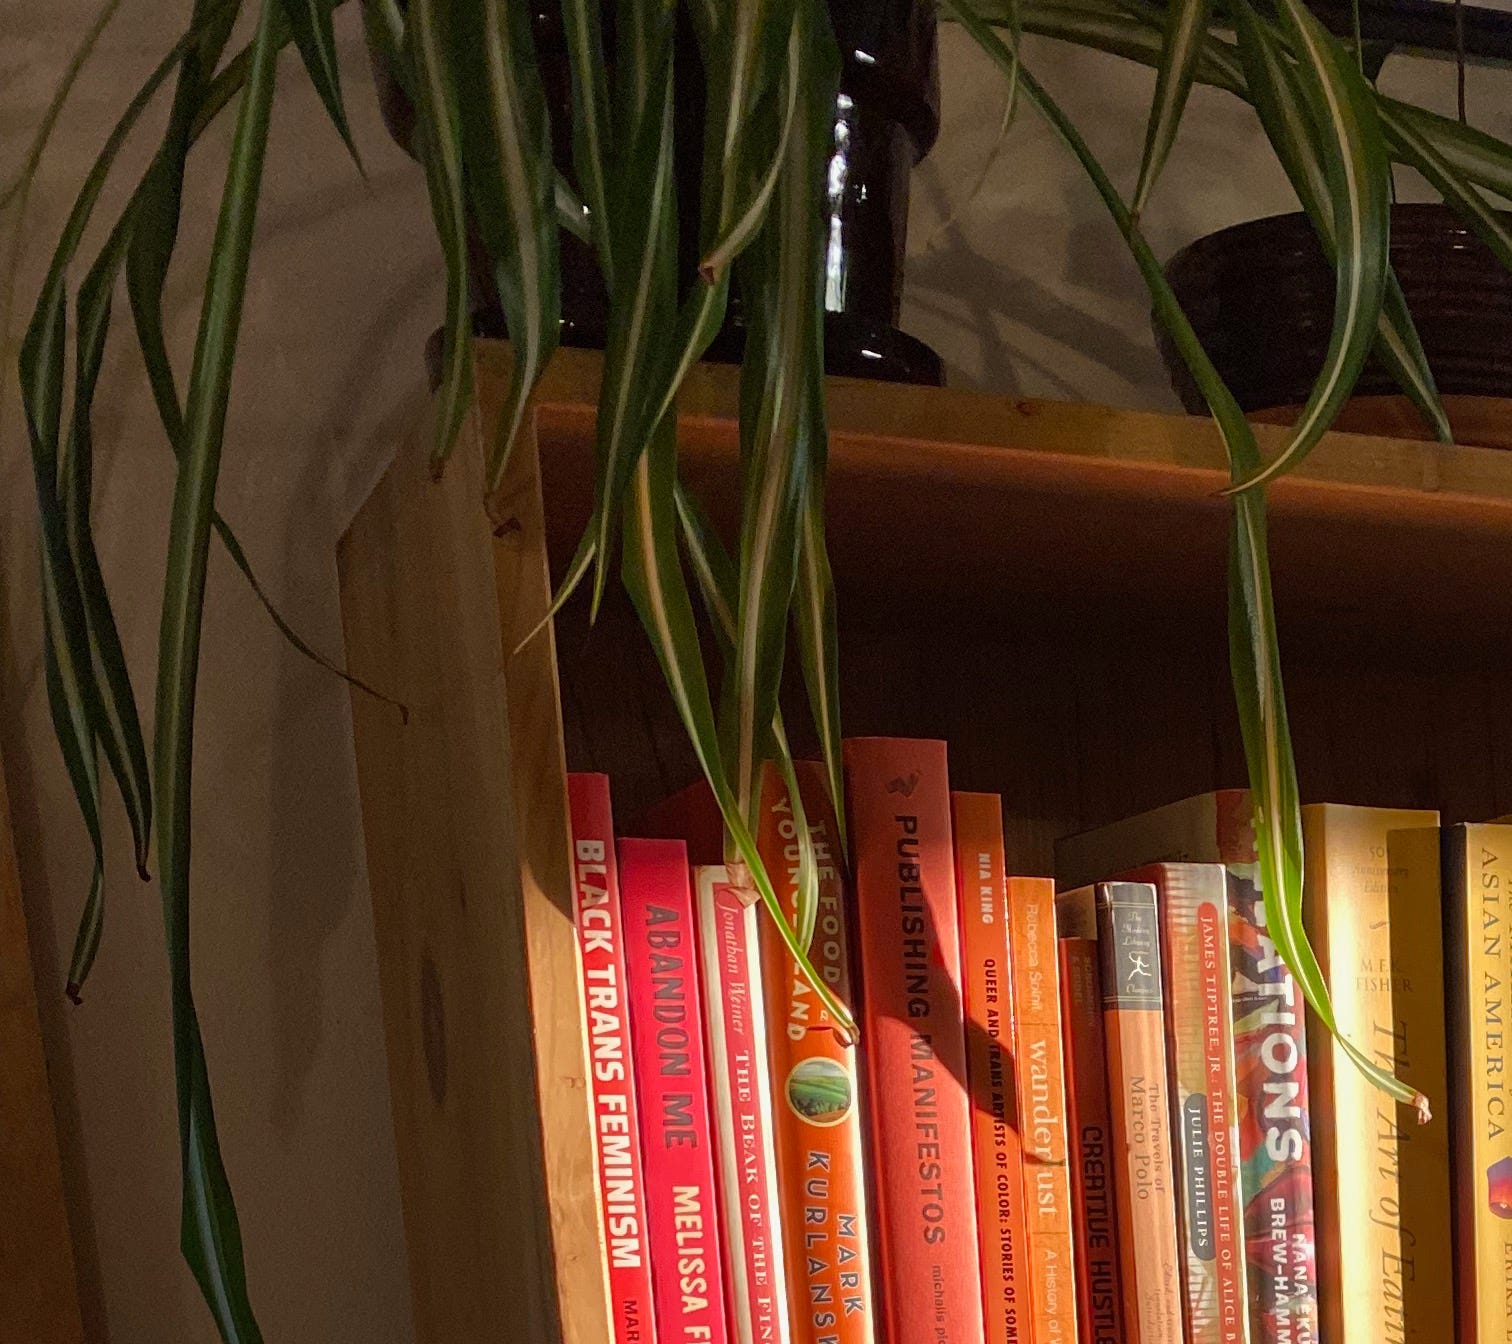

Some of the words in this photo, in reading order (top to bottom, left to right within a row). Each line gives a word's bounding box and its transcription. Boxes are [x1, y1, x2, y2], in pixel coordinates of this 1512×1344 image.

[575, 840, 620, 952] BLACK
[894, 814, 931, 1019] PUBLISHING
[1482, 847, 1501, 959] ASIAN
[586, 964, 629, 1081] TRANS
[1484, 971, 1505, 1141] AMERICA
[909, 1034, 947, 1245] MANIFESTOS
[1129, 1076, 1149, 1145] Marco
[592, 1094, 641, 1269] FEMINISM
[1132, 1152, 1154, 1200] Polo
[672, 1186, 711, 1314] MELISSA
[836, 1214, 863, 1317] MARK
